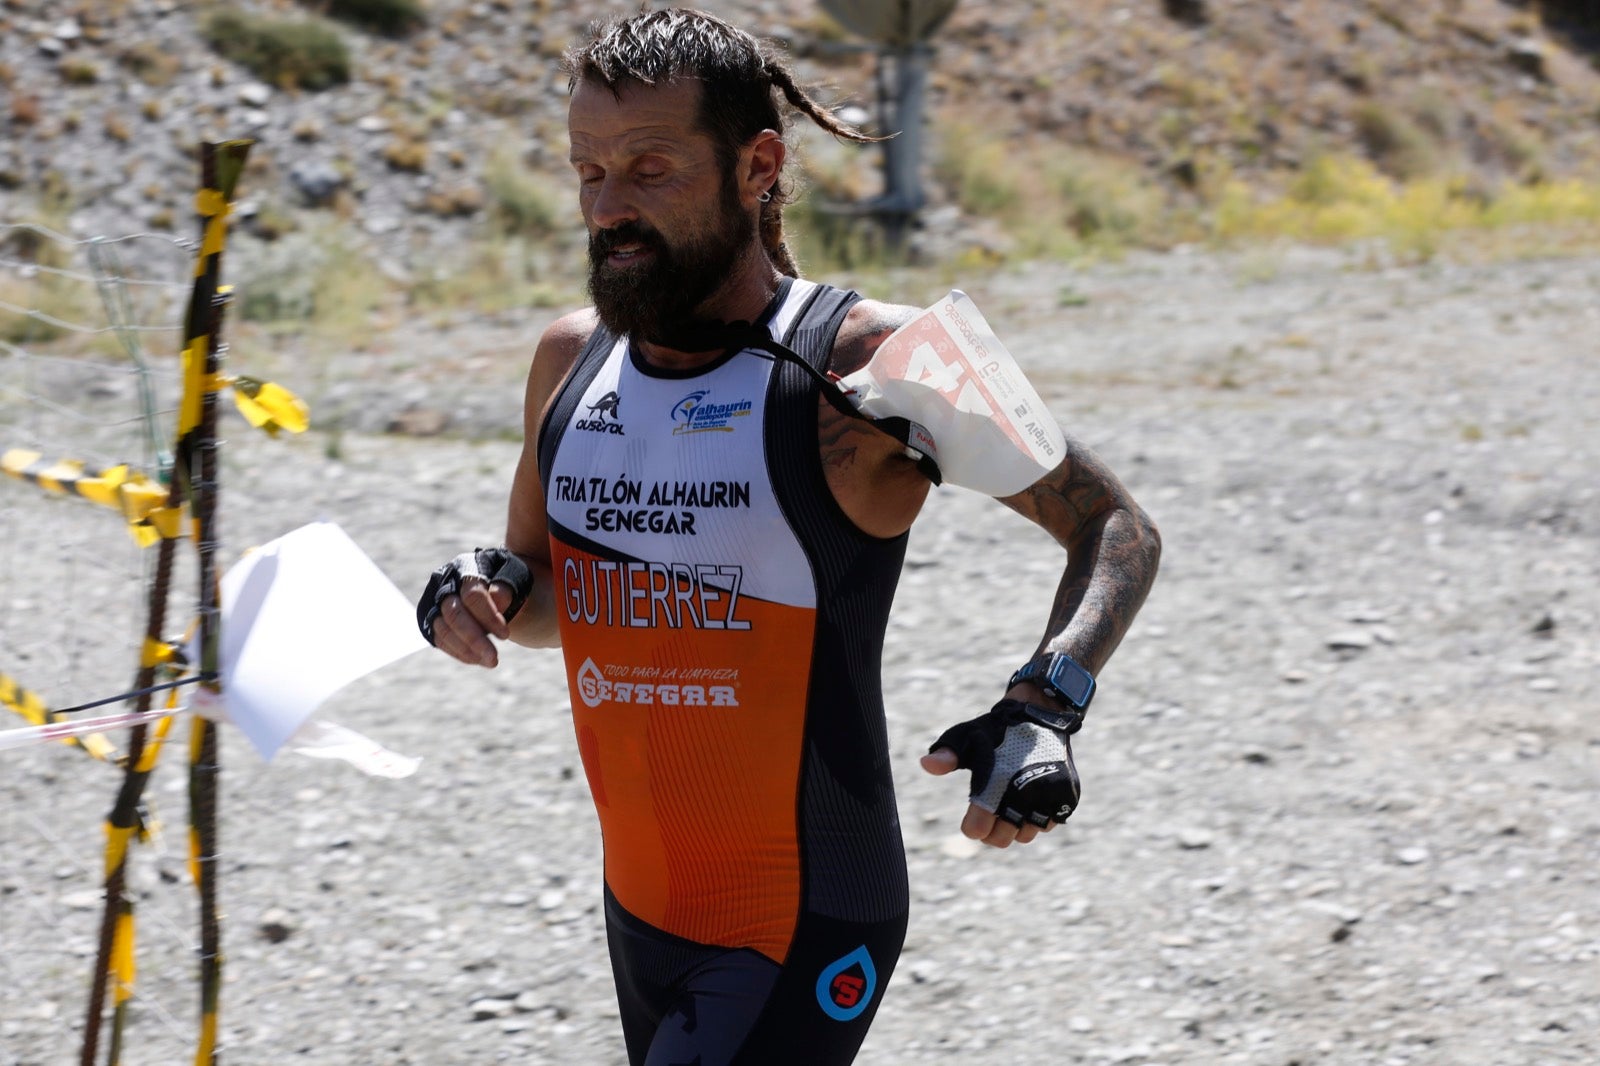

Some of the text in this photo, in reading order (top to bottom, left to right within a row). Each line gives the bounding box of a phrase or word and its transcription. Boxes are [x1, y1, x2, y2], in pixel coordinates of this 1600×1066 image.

[555, 473, 750, 508] TRIATLÓN ALHAURIN
[585, 508, 697, 535] SENEGAR
[564, 556, 752, 631] GUTIERREZ
[603, 664, 739, 680] TODO PARA LA LIMPIEZA
[582, 677, 740, 707] SENEGAR
